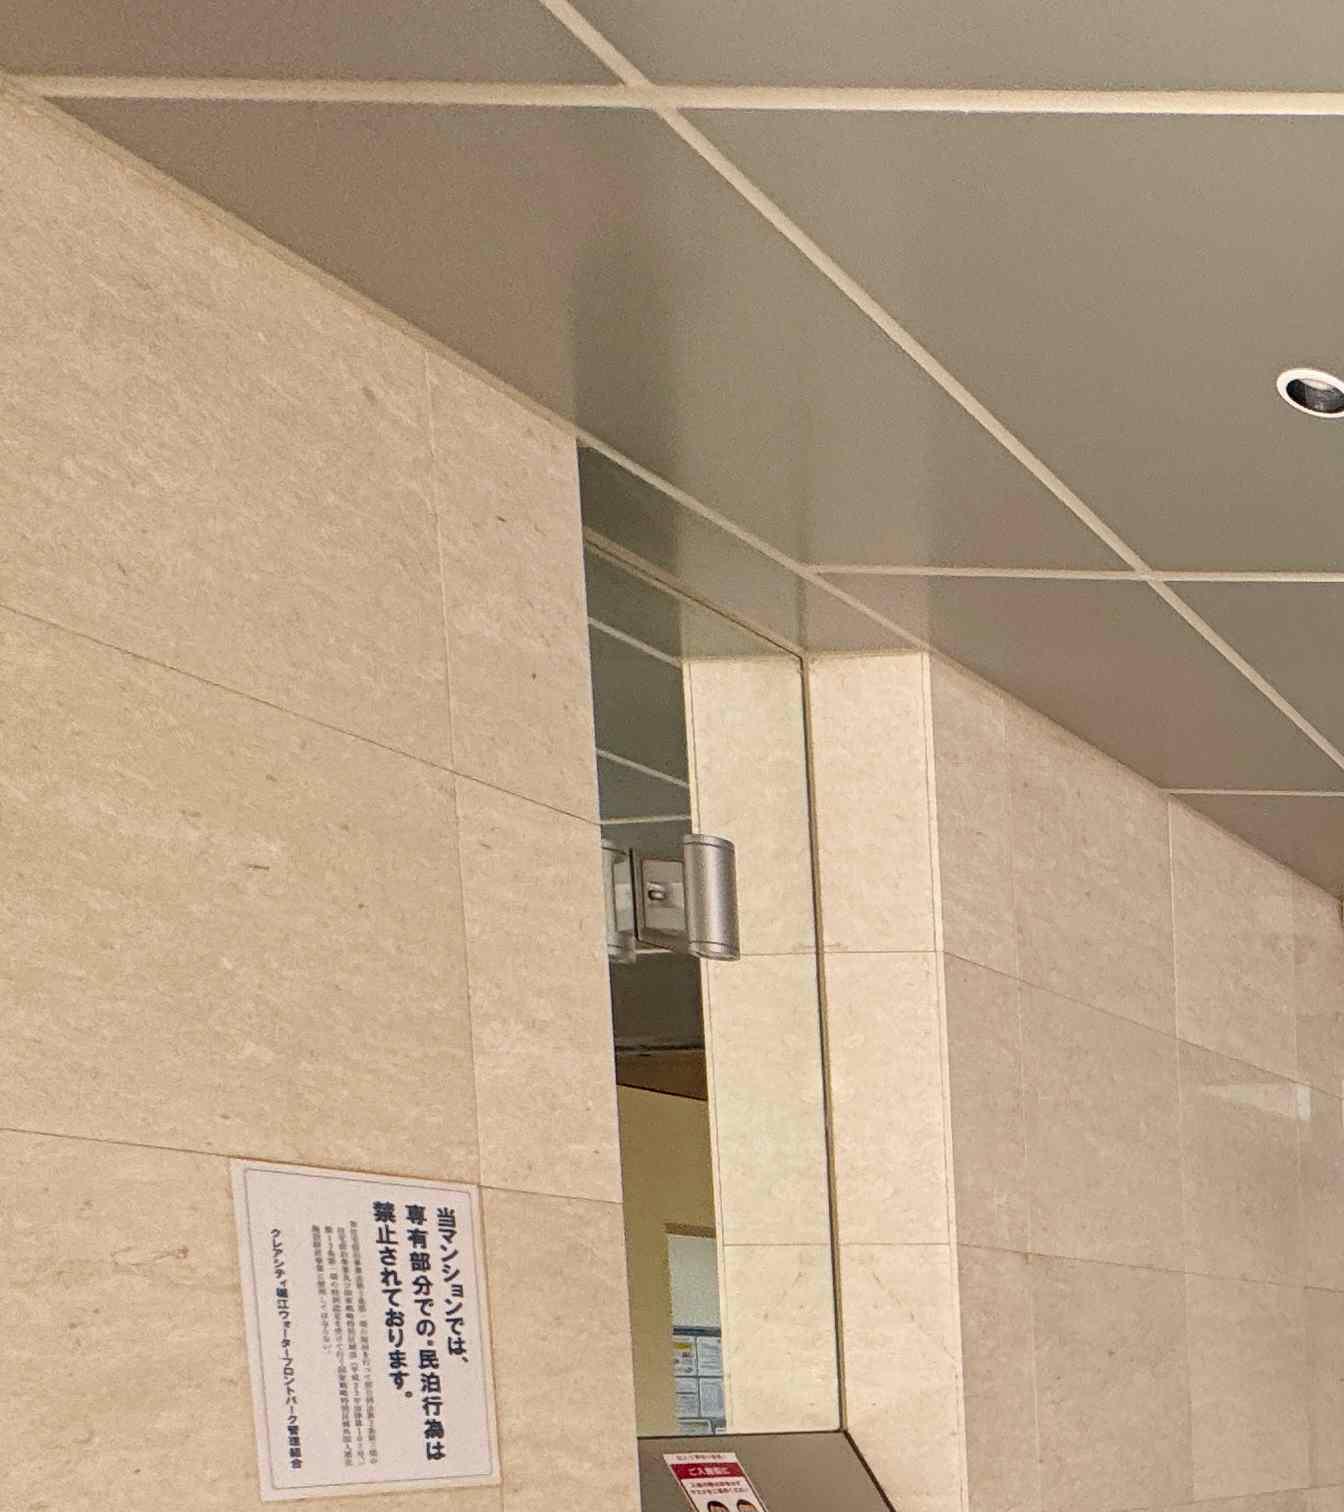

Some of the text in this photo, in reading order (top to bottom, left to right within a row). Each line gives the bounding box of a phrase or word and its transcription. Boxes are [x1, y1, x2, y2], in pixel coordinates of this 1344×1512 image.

[372, 1201, 414, 1399] 禁止されております。
[436, 1206, 469, 1363] 当マンションでは、
